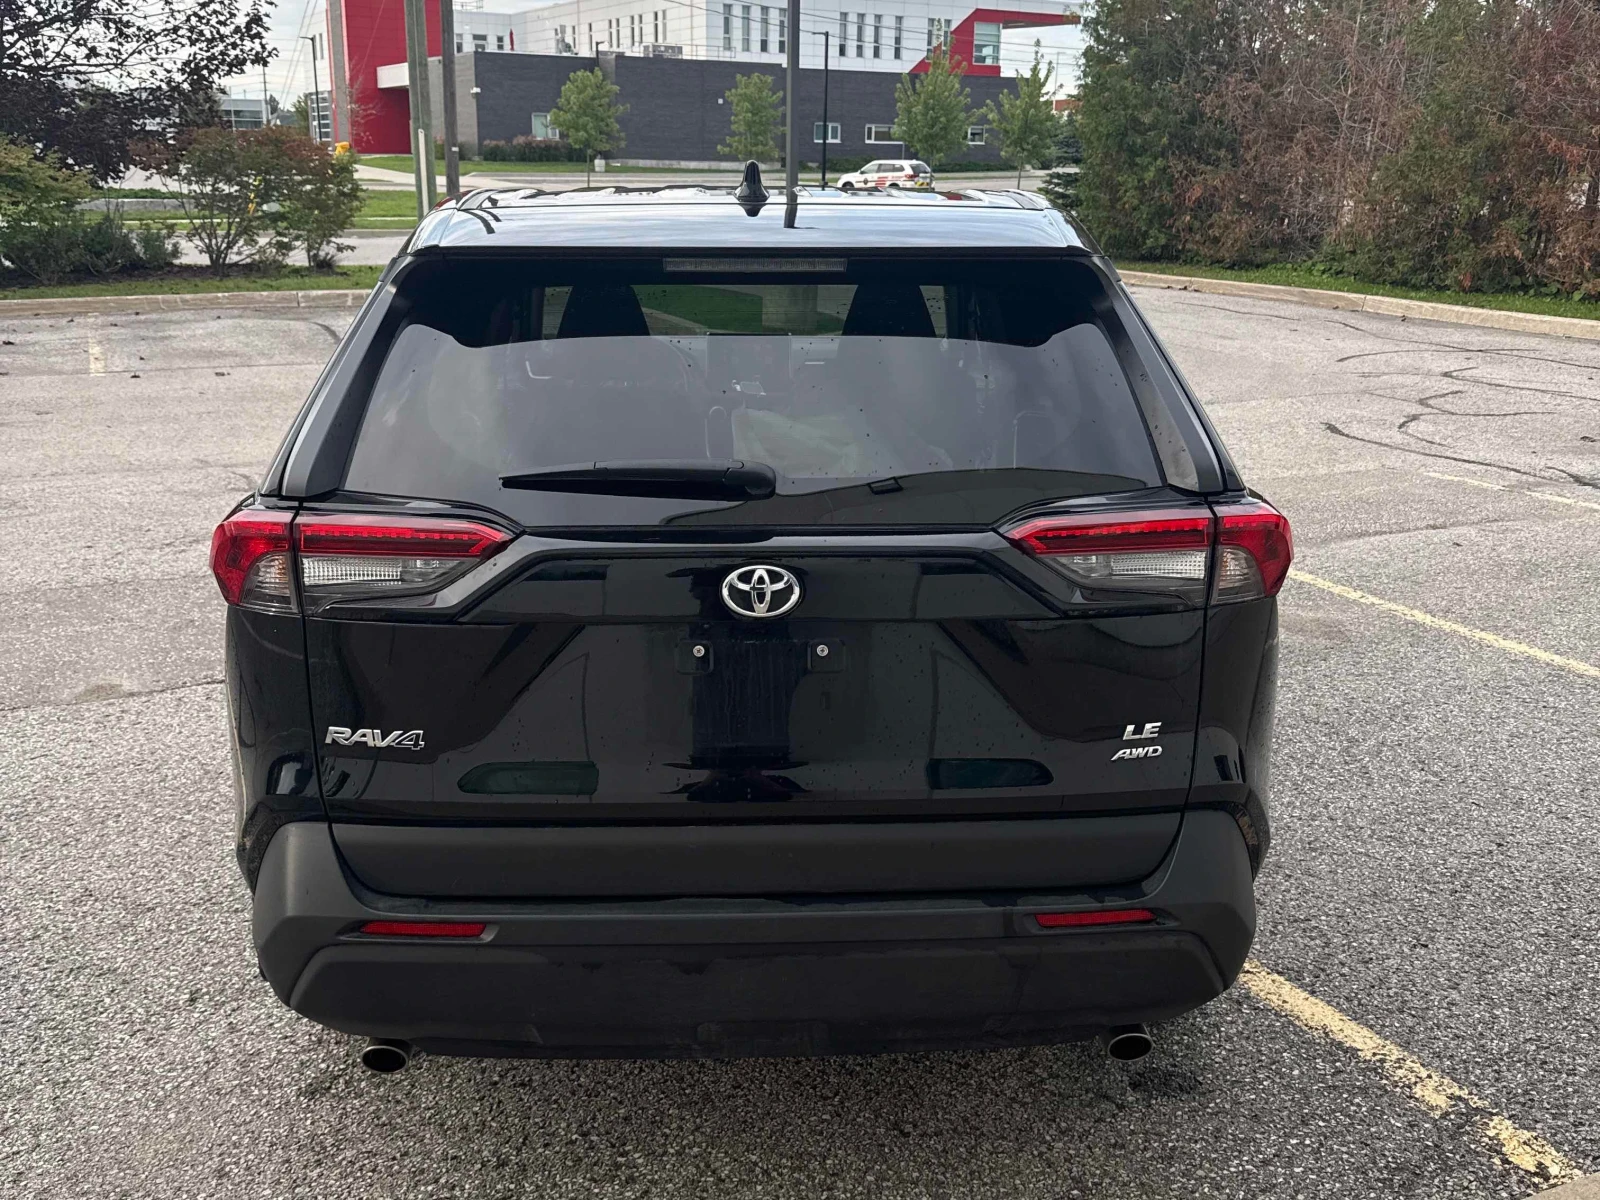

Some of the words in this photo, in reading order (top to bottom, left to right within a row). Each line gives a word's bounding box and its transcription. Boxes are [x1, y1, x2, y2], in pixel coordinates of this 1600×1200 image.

[325, 726, 425, 750] RAV4
[1122, 722, 1162, 740] LE
[1110, 745, 1162, 760] AWD
